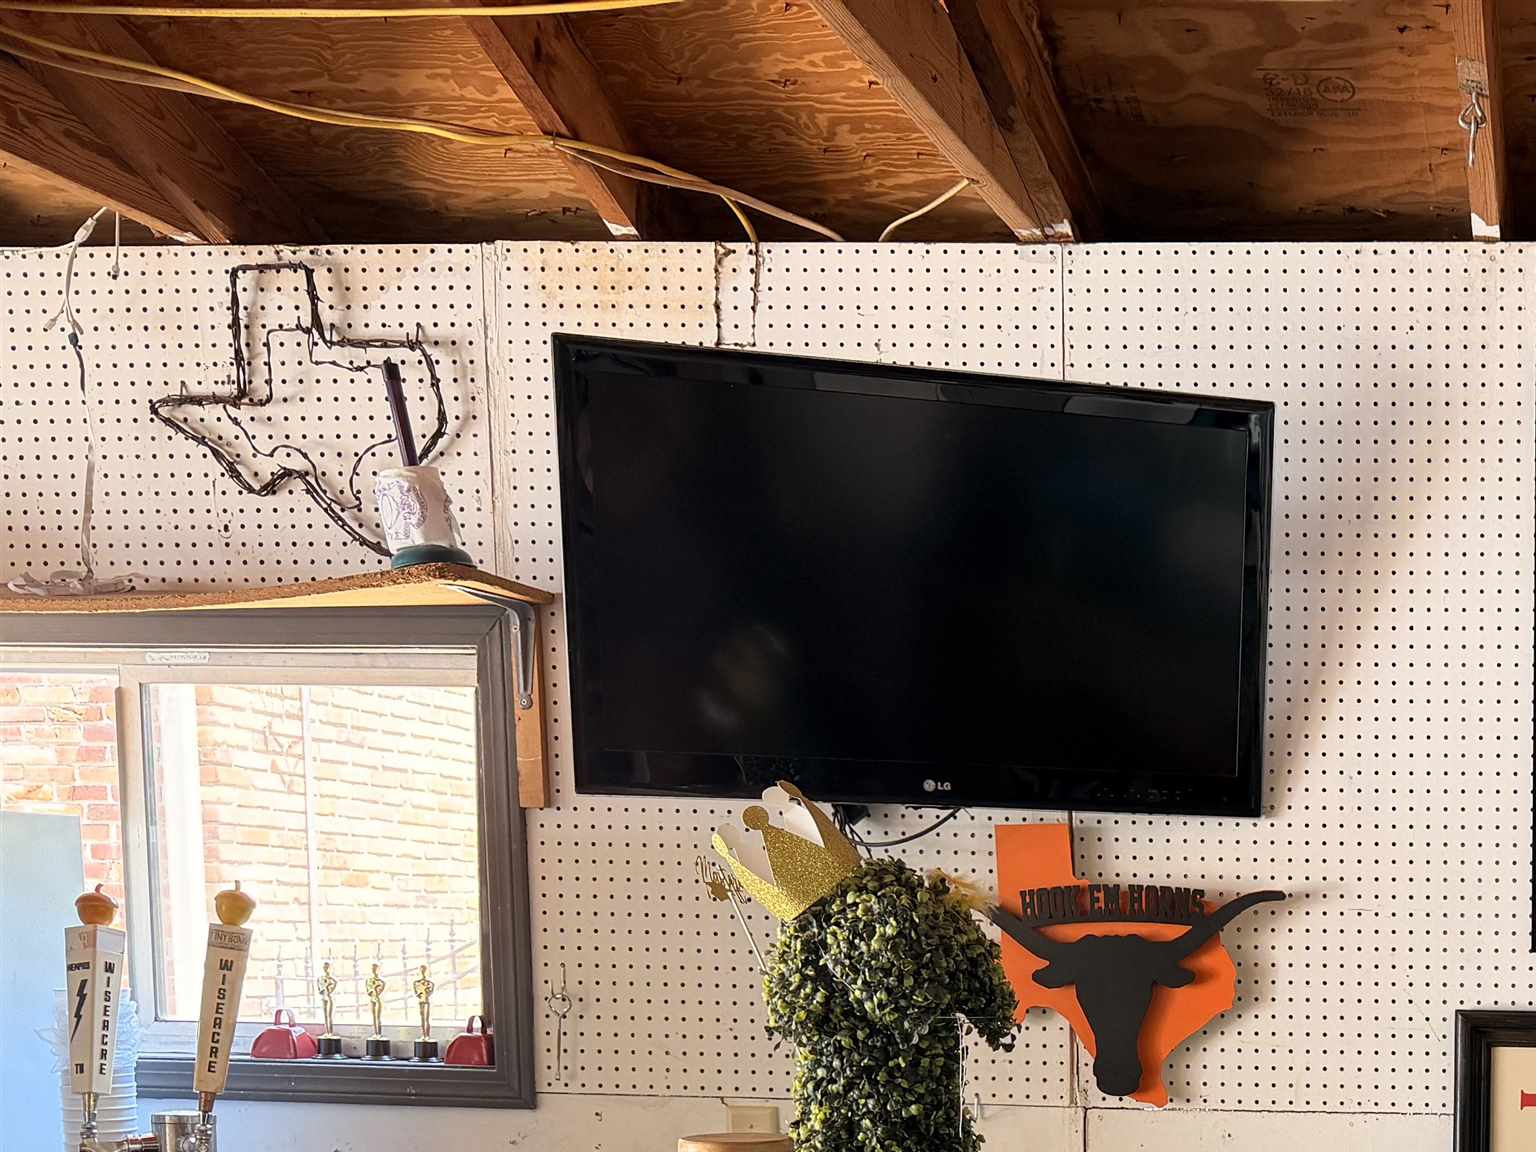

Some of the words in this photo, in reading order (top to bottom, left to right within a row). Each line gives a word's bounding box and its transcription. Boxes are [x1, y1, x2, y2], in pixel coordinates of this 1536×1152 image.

[1019, 885, 1081, 921] HOOK
[1088, 884, 1120, 915] EM
[1128, 884, 1206, 918] HORNS
[99, 960, 116, 1076] WISEACRE
[207, 958, 234, 1074] WISEACRE
